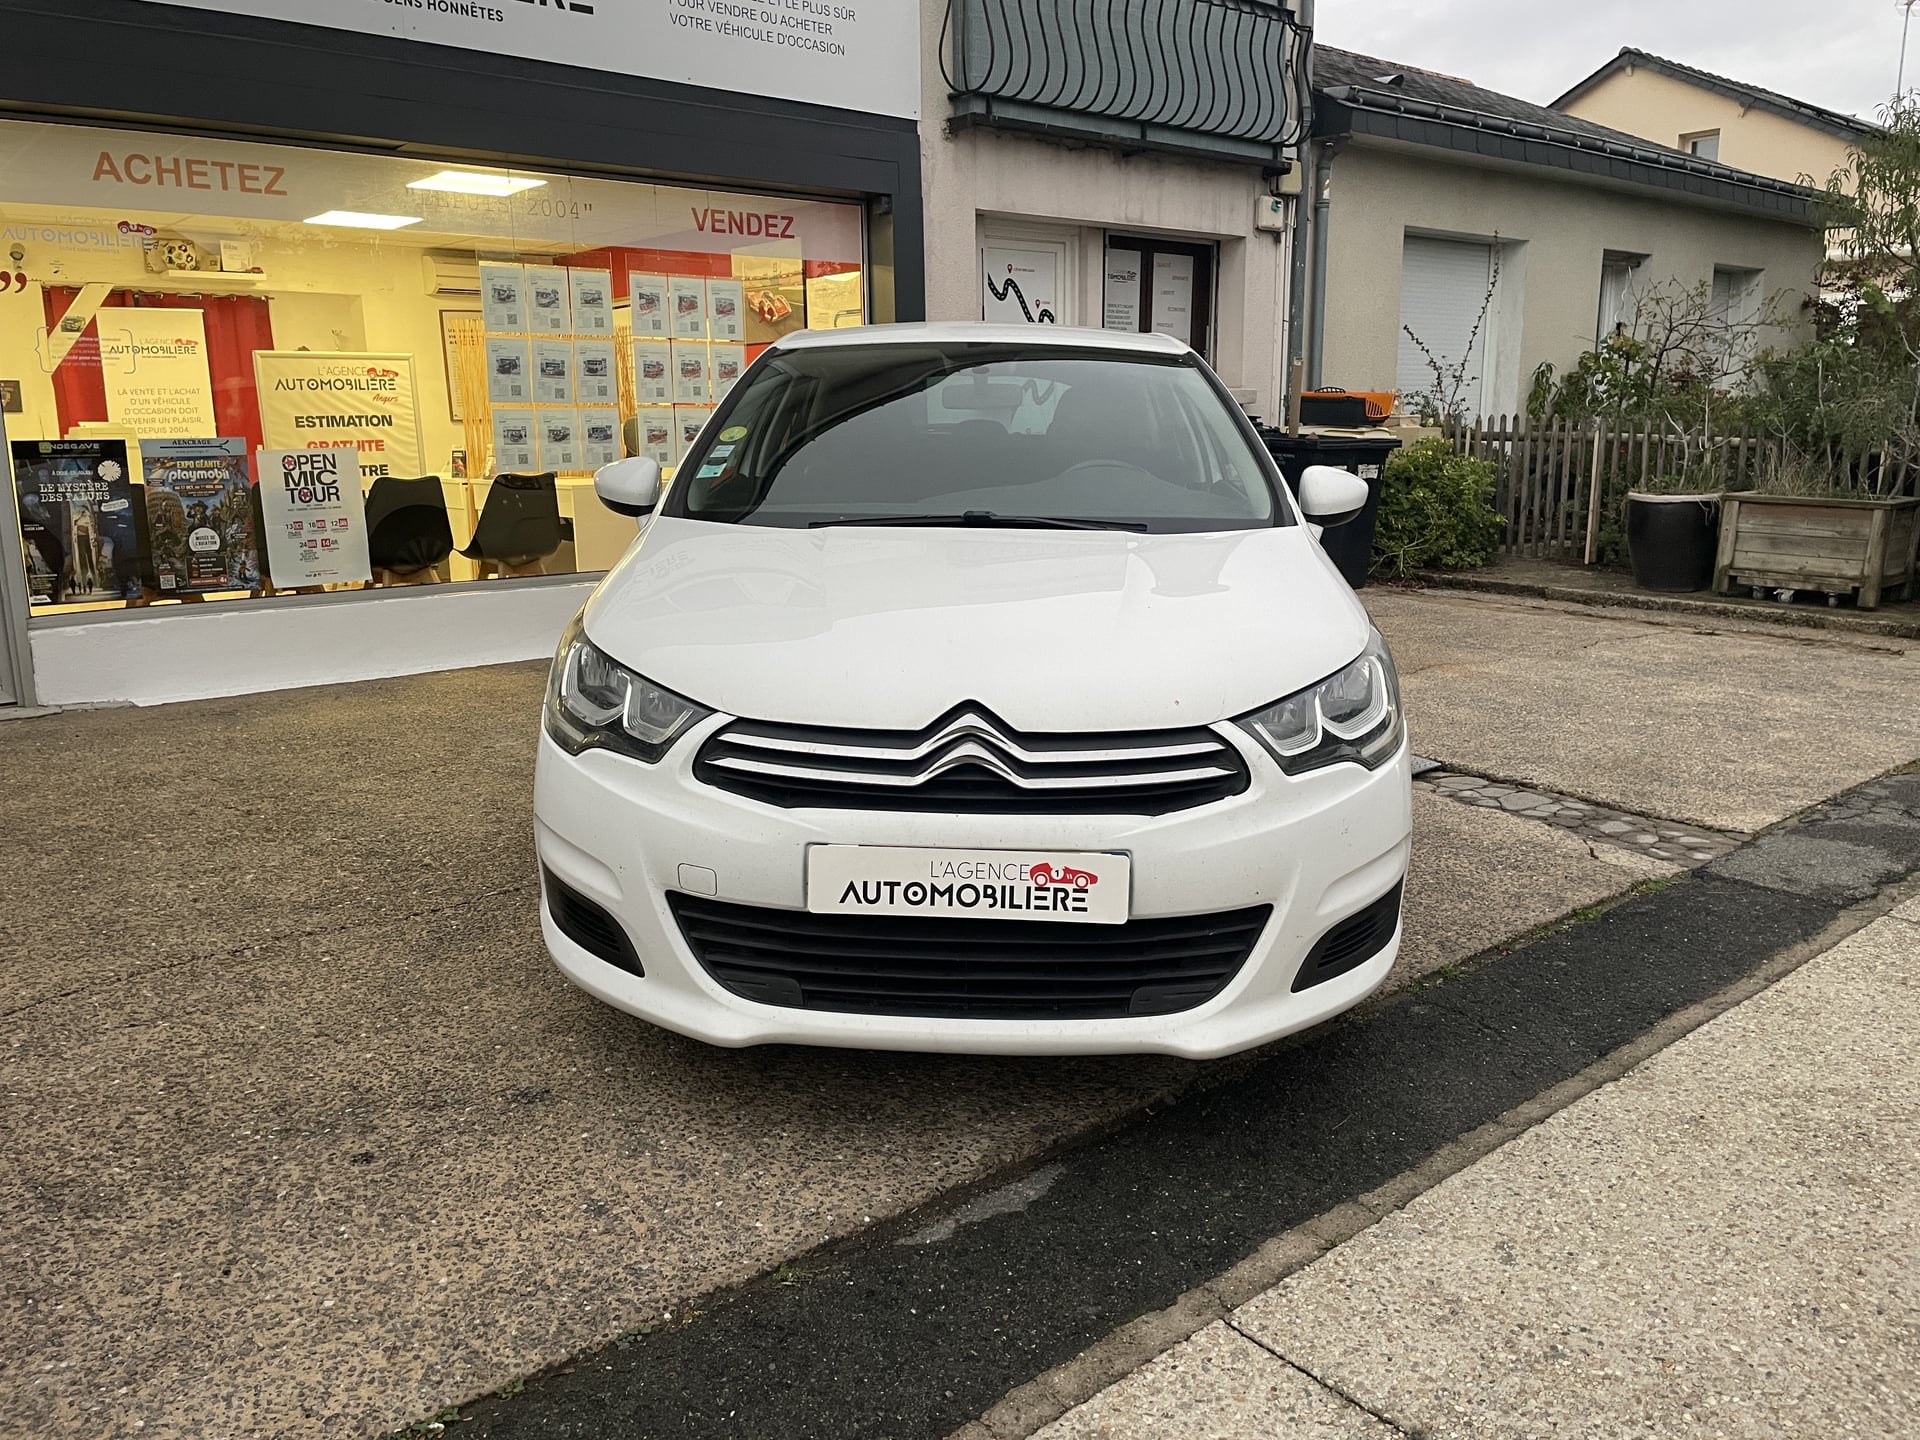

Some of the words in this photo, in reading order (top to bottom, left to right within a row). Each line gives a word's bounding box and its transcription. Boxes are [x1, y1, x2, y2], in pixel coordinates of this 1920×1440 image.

[427, 0, 504, 22] HONNÊTES
[707, 0, 758, 21] VENDRE
[760, 11, 778, 25] OU
[780, 15, 833, 35] ACHETER
[786, 0, 800, 10] LE
[802, 1, 831, 17] PLUS
[833, 6, 856, 22] SÛR
[669, 12, 713, 32] VOTRE
[716, 20, 774, 43] VÉHICULE
[777, 32, 846, 56] D'OCCASION
[92, 151, 289, 196] ACHETEZ
[691, 207, 796, 239] VENDEZ
[317, 366, 367, 377] L'AGENCE
[117, 388, 128, 396] LA
[129, 387, 155, 396] VENTE
[157, 387, 167, 396] ET
[169, 387, 201, 396] L'ACHAT
[372, 392, 399, 405] Angers
[130, 397, 151, 406] D'UN
[152, 396, 192, 405] VÉHICULE
[124, 407, 177, 415] D'OCCASION
[178, 406, 198, 415] DOIT
[121, 417, 157, 425] DEVENIR
[158, 417, 170, 425] UN
[294, 414, 393, 429] ESTIMATION
[137, 426, 167, 434] DEPUIS
[176, 460, 194, 469] EXPO
[281, 453, 337, 472] OPEN
[168, 468, 230, 483] playmobil
[283, 469, 338, 488] MIC
[38, 483, 55, 493] LE
[56, 479, 109, 492] MYSTÈRE
[40, 493, 63, 502] DES
[285, 486, 341, 504] TOUR
[930, 860, 1030, 882] L'AGENCE
